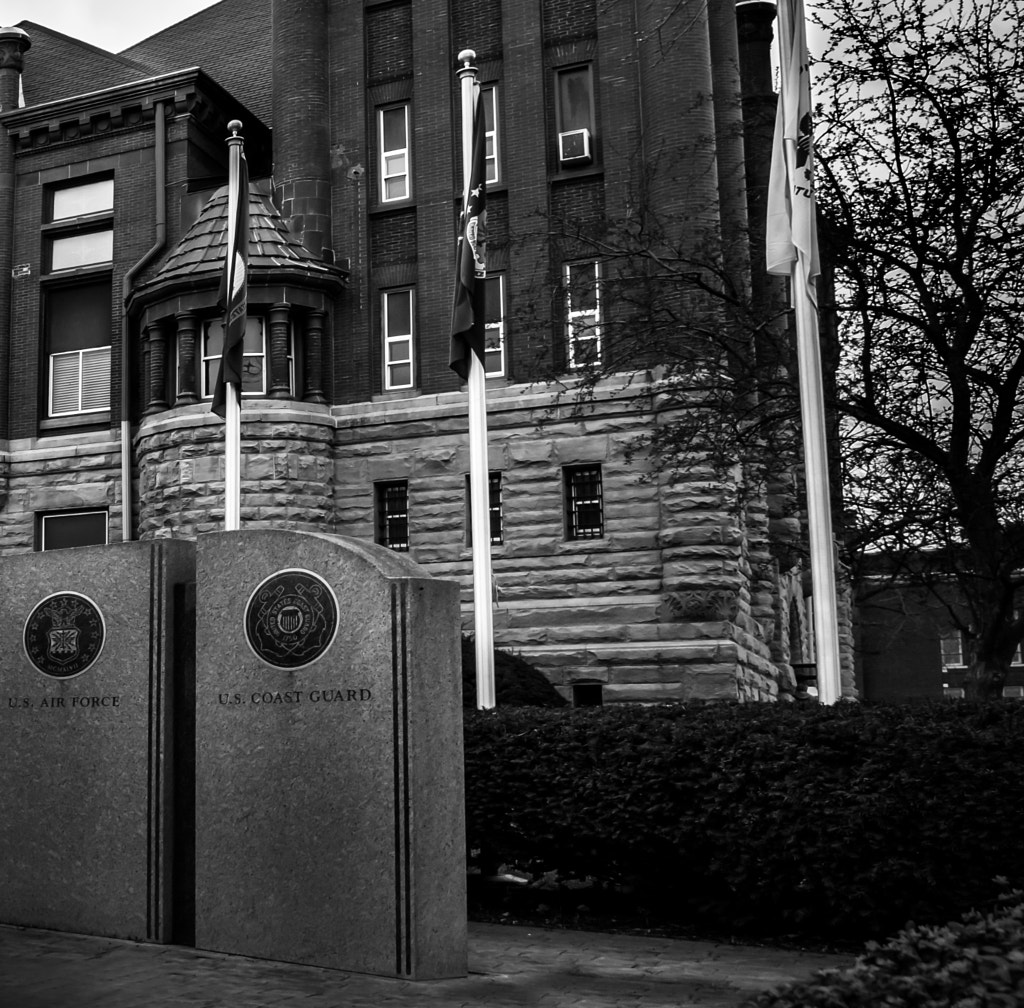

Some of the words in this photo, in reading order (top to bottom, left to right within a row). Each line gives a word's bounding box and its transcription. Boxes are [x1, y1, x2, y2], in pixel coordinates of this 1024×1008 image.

[8, 697, 34, 708] U.S.
[40, 697, 66, 708] AIR
[72, 696, 121, 708] FORCE
[218, 693, 246, 705] U.S.
[251, 691, 303, 705] COAST
[309, 689, 372, 703] GUARD
